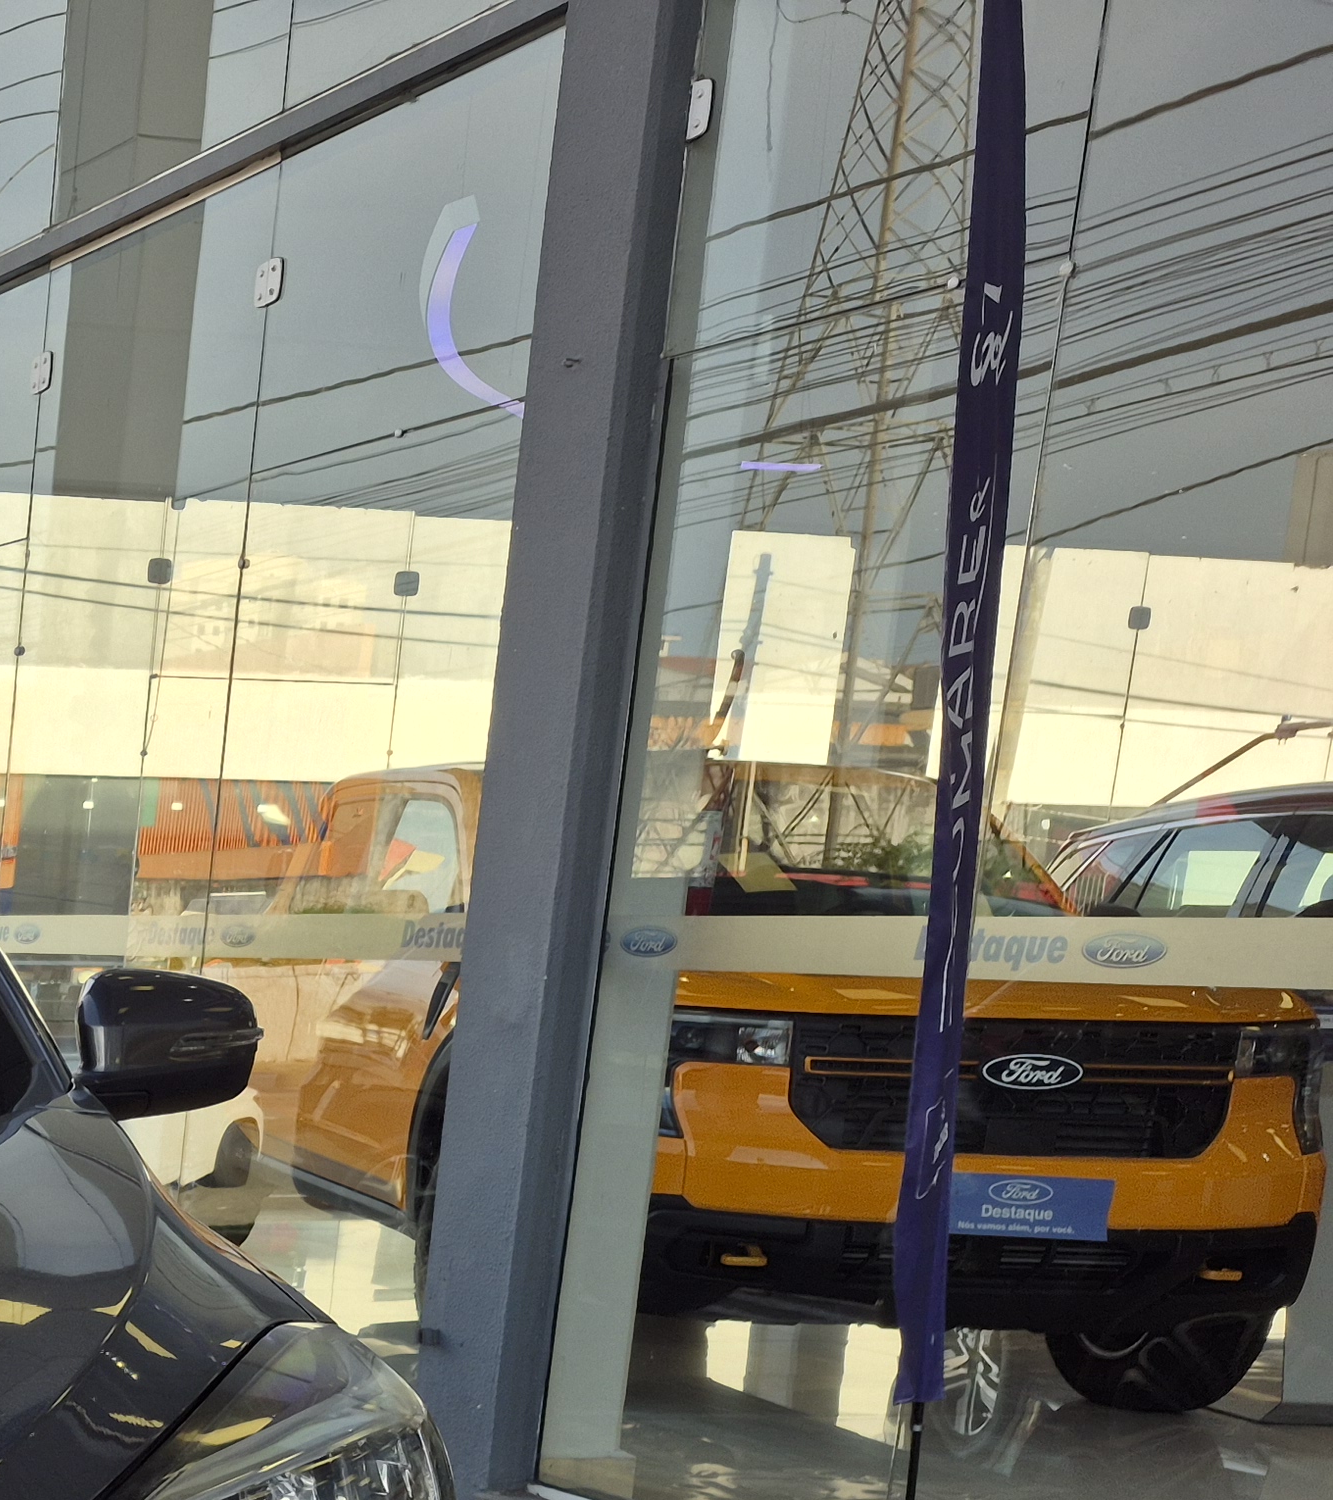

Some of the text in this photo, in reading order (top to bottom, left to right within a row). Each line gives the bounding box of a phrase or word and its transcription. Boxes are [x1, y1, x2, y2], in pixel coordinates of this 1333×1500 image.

[401, 920, 467, 955] Destaq
[913, 924, 1151, 972] taque Ford
[1000, 1057, 1063, 1084] Ford
[1001, 1182, 1041, 1200] Ford
[981, 1204, 1053, 1222] Destaque
[958, 1220, 1075, 1235] Nós vamos além, por você.
